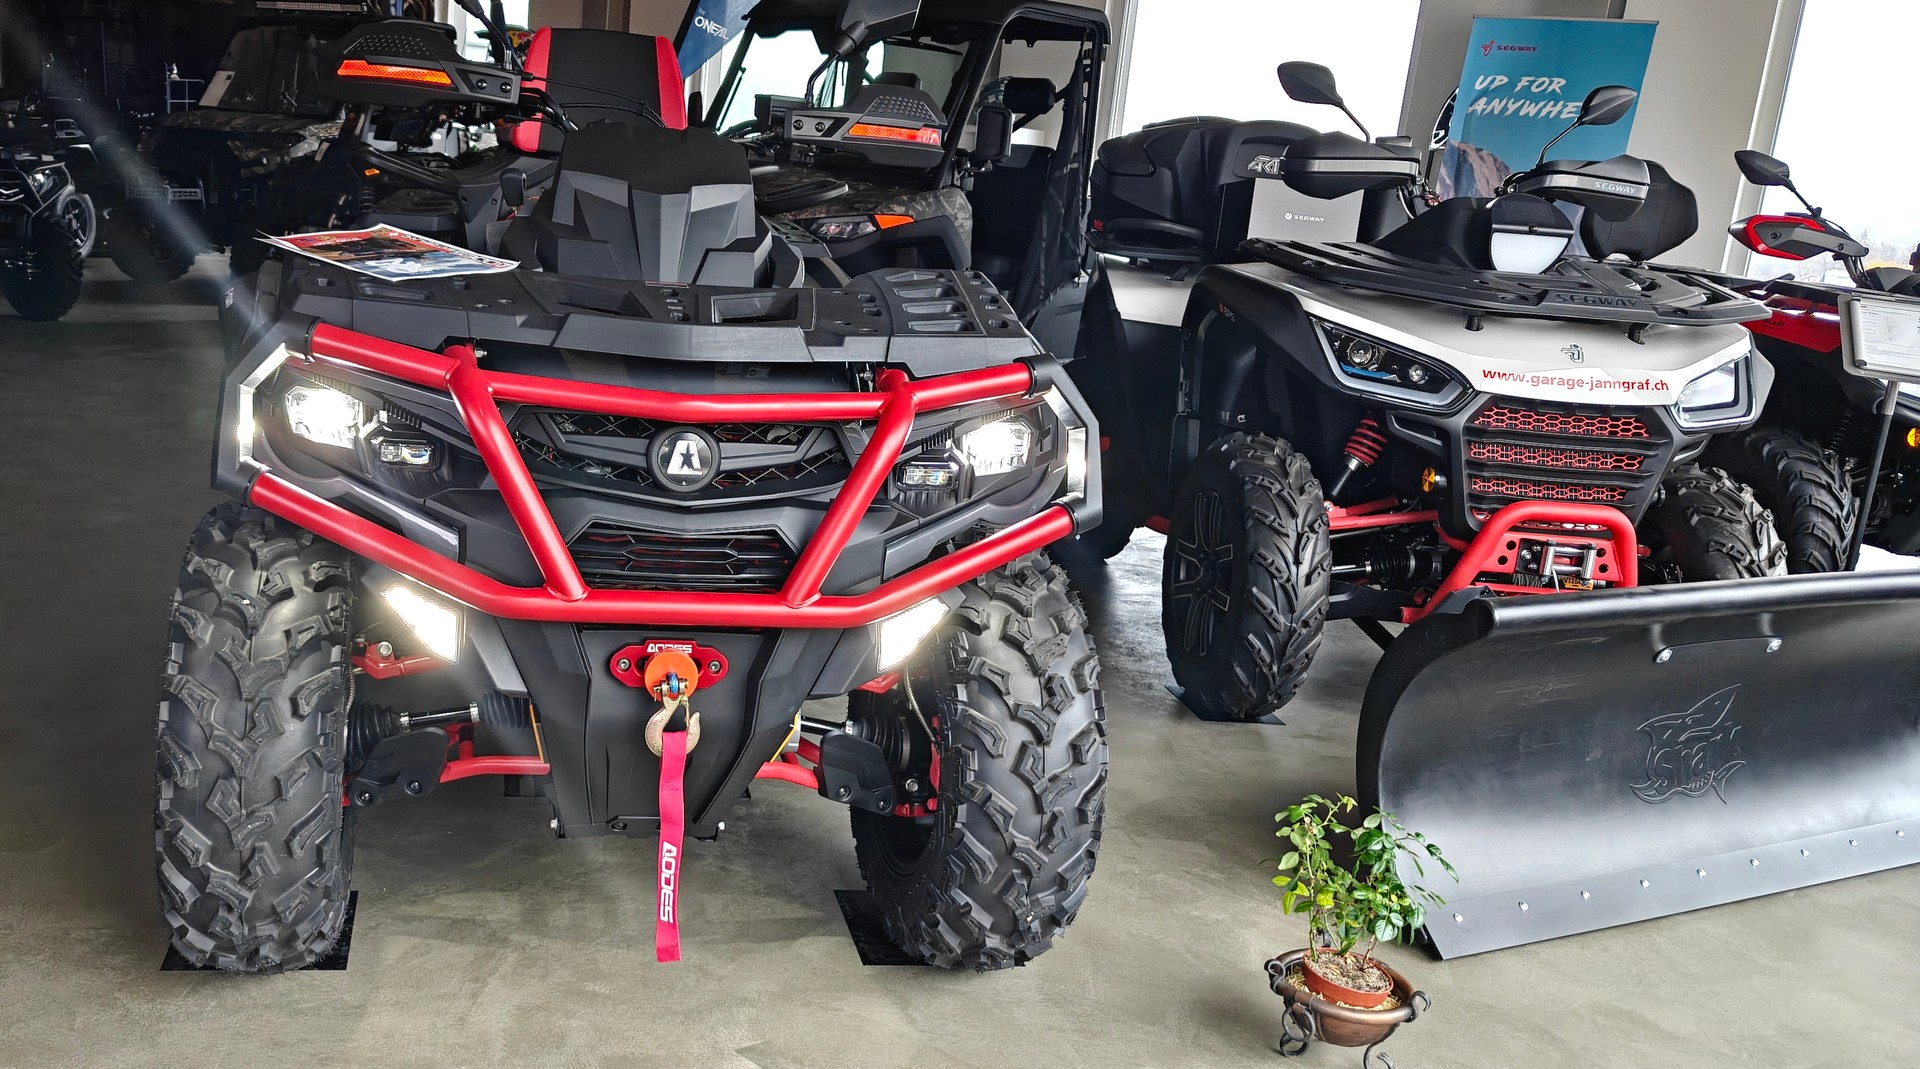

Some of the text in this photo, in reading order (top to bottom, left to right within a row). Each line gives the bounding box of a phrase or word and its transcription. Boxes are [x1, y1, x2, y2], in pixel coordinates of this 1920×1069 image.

[1496, 44, 1537, 52] SEGWAY
[1474, 75, 1567, 95] UP FOR
[1593, 181, 1637, 195] SEGWAY
[1293, 214, 1325, 223] SEGWAY
[1554, 293, 1638, 308] SEGWAY
[1482, 369, 1669, 392] www.garage-janngraf.ch
[660, 841, 677, 924] AODES
